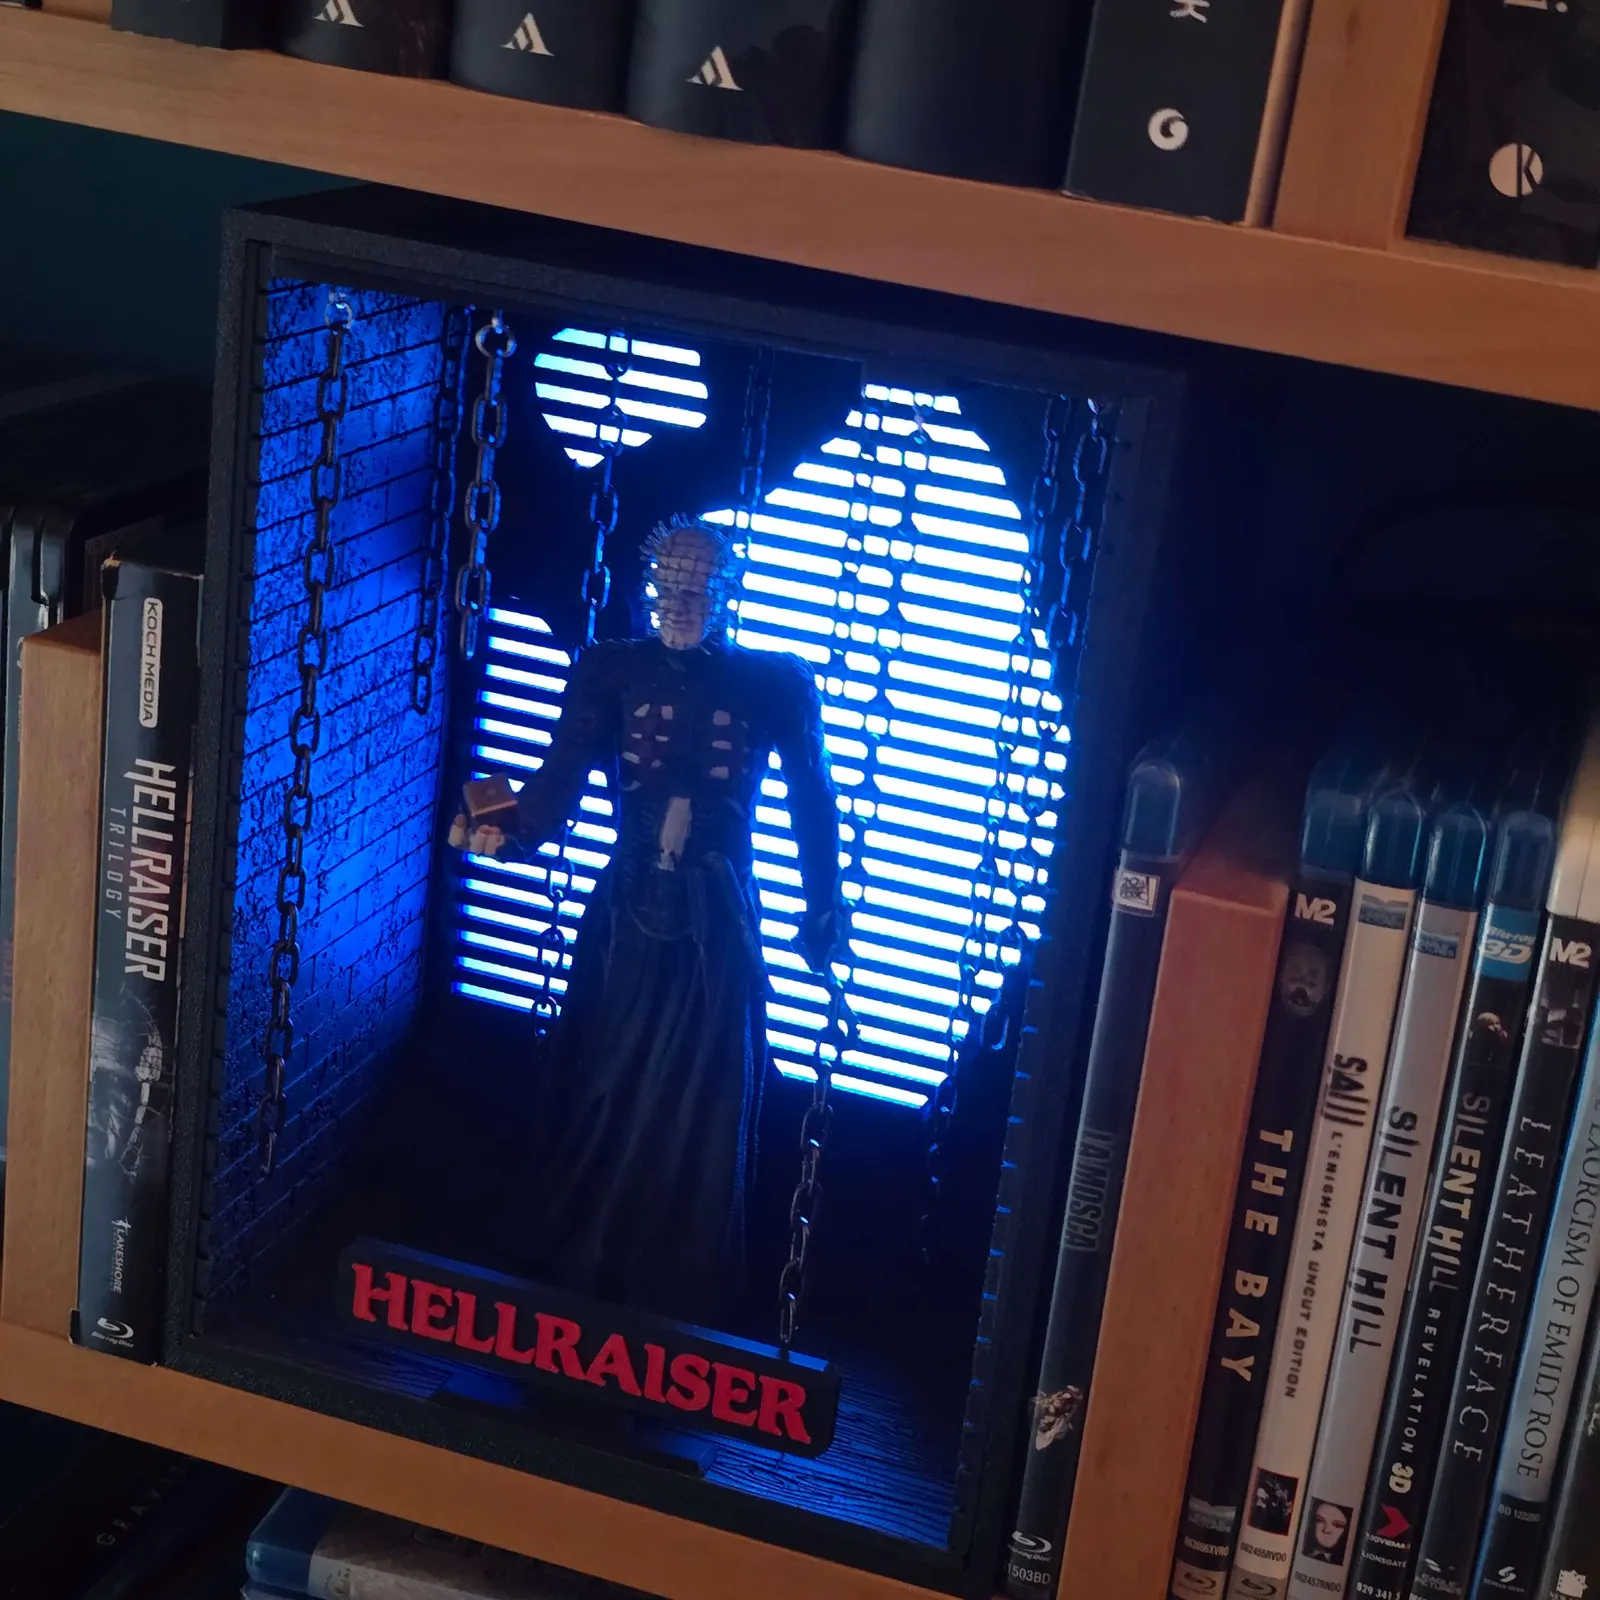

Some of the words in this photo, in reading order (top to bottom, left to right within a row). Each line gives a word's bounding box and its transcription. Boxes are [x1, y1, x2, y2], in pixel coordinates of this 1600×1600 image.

[144, 601, 158, 659] KOCH
[142, 662, 156, 722] MEDIA
[105, 807, 127, 919] TRILOGY
[123, 758, 177, 982] HELLRAISER
[1294, 892, 1337, 925] M2
[1550, 937, 1592, 969] M2
[1244, 1129, 1294, 1237] THE
[1312, 1131, 1344, 1251] L'ENIGMISTA
[1363, 1105, 1421, 1260] SILENT
[1438, 1092, 1491, 1220] SILENT
[112, 1228, 126, 1294] LAKESHORE
[1300, 1261, 1321, 1321] UNCUT
[1428, 1224, 1462, 1293] HILL
[1453, 1116, 1551, 1463] LEATHERFACE
[1552, 1276, 1580, 1316] OF
[1220, 1270, 1269, 1382] BAY
[1348, 1267, 1389, 1353] HILL
[351, 1262, 812, 1445] HELLRAISER
[1284, 1326, 1309, 1399] EDITION
[1400, 1307, 1441, 1455] REVELATION
[1533, 1319, 1572, 1407] EMILY
[1388, 1462, 1415, 1494] 3D
[1516, 1409, 1552, 1479] ROSE
[1356, 1581, 1374, 1596] 829
